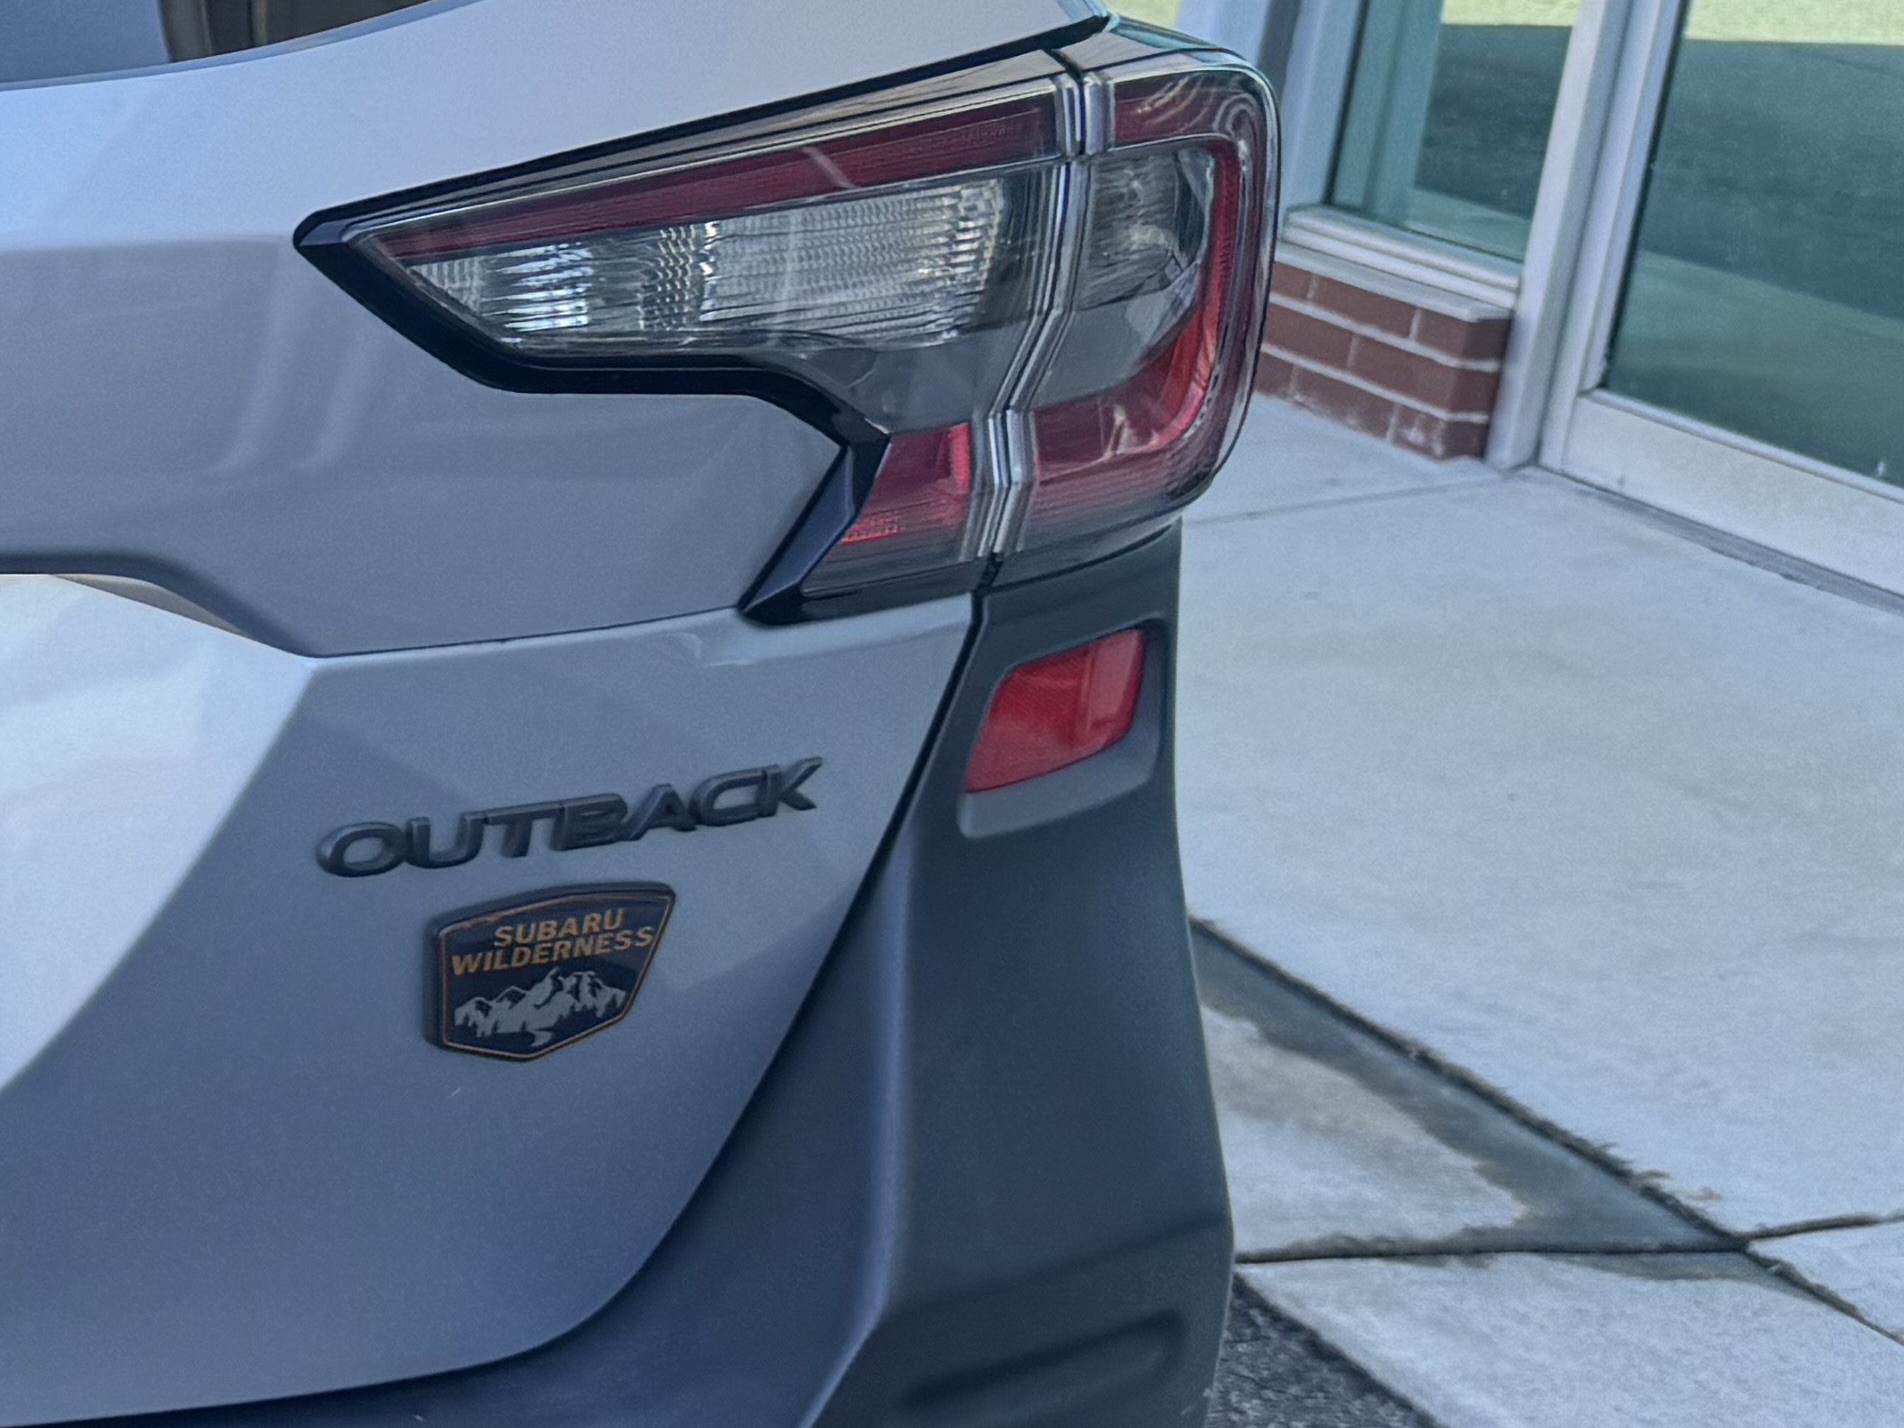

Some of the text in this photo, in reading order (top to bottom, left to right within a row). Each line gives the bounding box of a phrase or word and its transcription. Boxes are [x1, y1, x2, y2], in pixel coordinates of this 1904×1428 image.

[316, 756, 823, 878] OUTBACK
[451, 926, 655, 976] WILDERNESS
[494, 908, 624, 948] SUBARU
